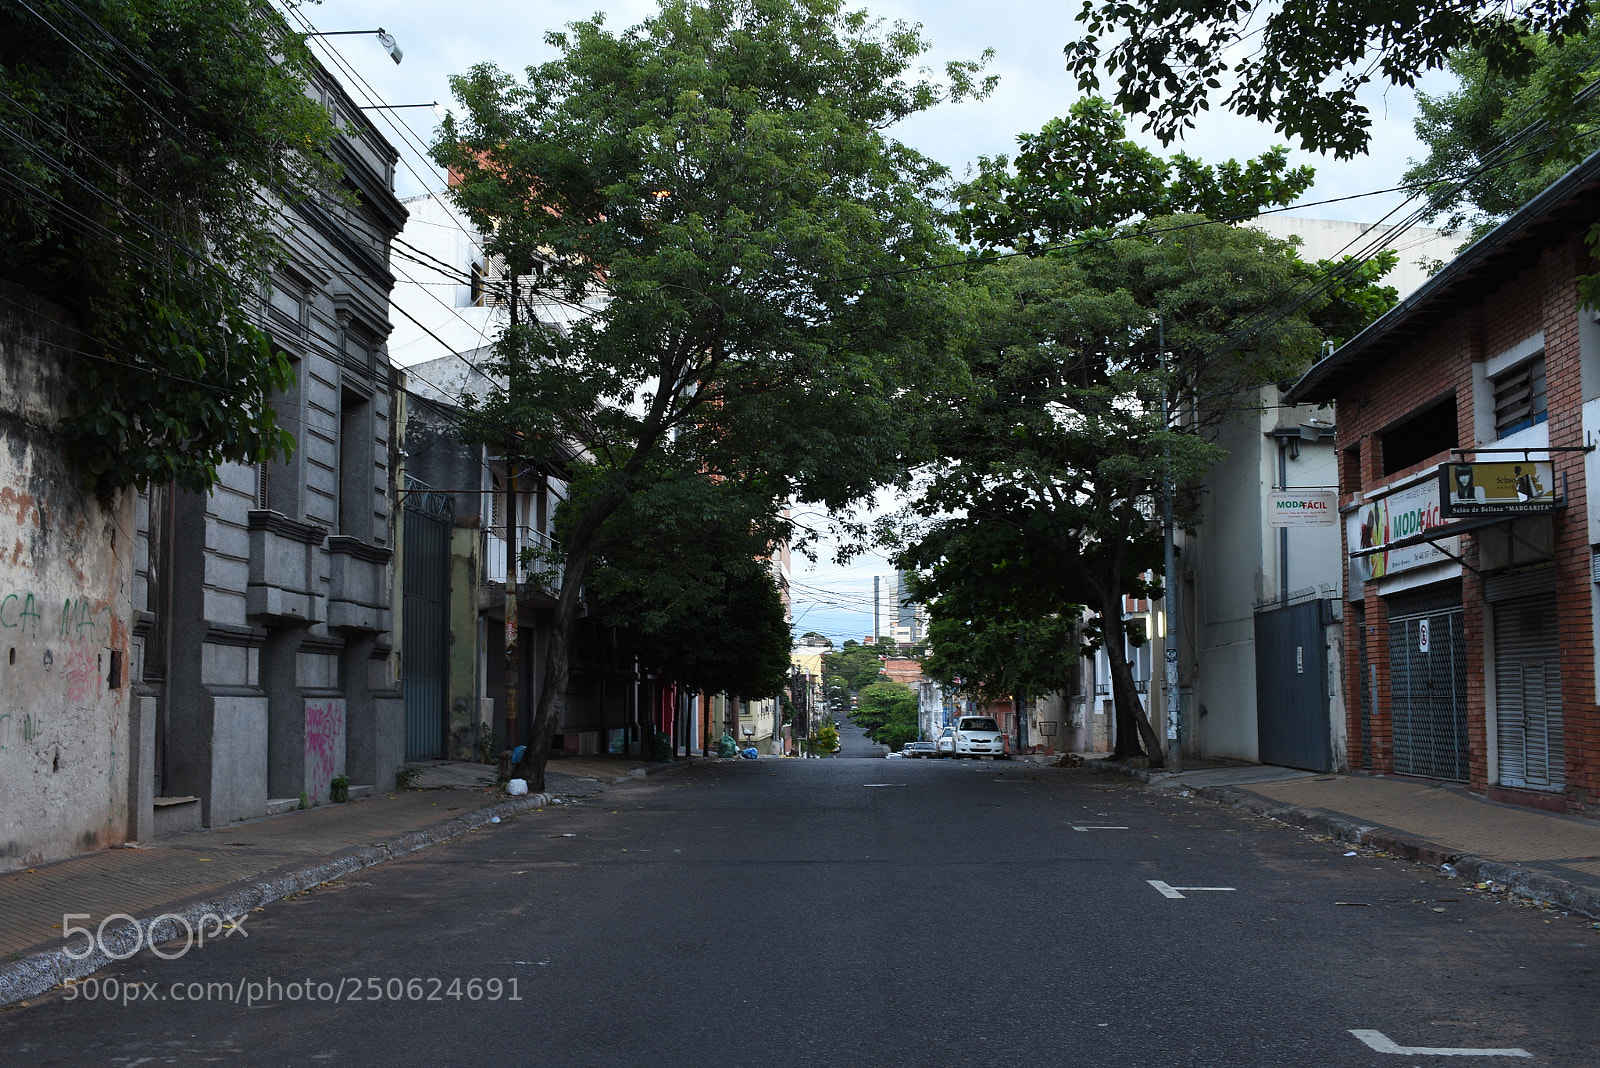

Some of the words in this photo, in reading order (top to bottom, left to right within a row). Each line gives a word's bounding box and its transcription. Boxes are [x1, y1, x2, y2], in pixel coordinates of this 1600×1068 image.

[1276, 500, 1328, 510] MODAFÁCIL
[1452, 506, 1470, 514] Salón
[1471, 505, 1480, 513] de
[1481, 504, 1503, 513] Belleza
